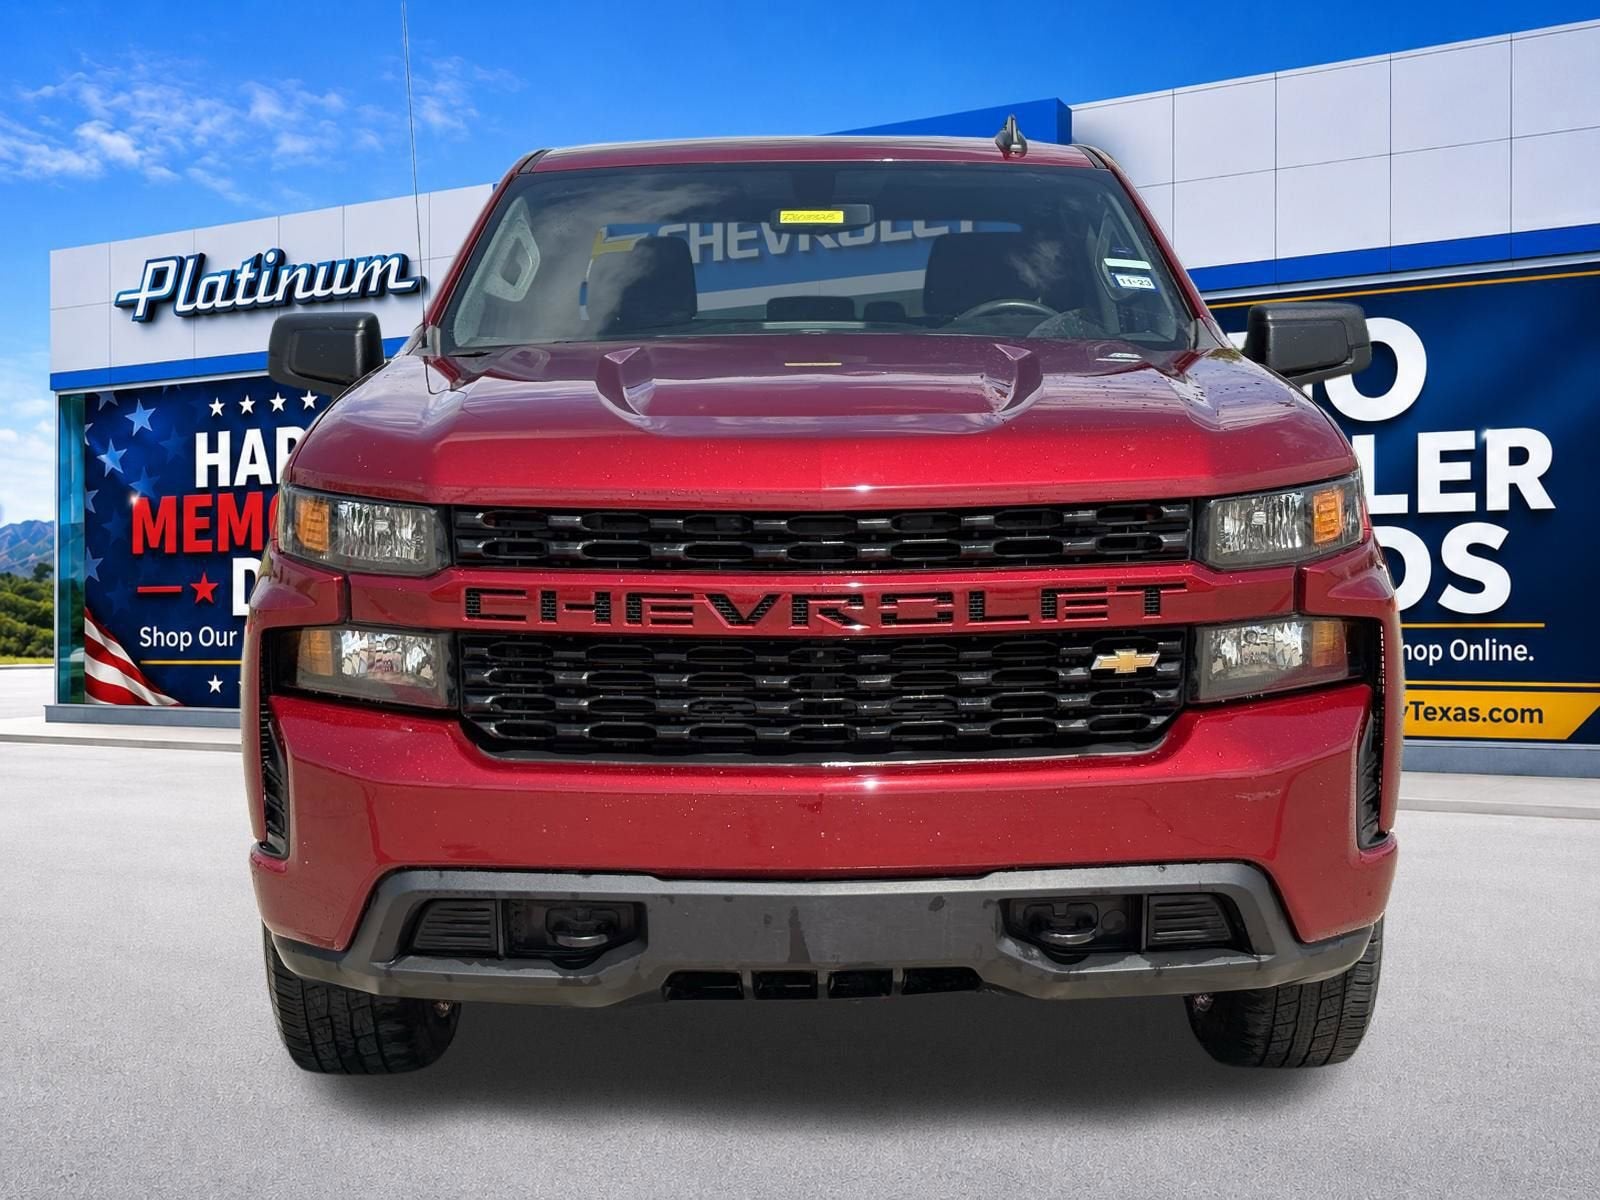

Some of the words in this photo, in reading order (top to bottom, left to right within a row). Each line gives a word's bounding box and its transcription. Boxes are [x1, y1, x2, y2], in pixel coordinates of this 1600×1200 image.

[115, 249, 424, 321] Platinum
[132, 491, 278, 554] MEM
[464, 582, 1188, 629] CHEVROLET
[139, 626, 193, 652] Shop
[198, 626, 238, 647] Our
[1450, 638, 1535, 661] Online.
